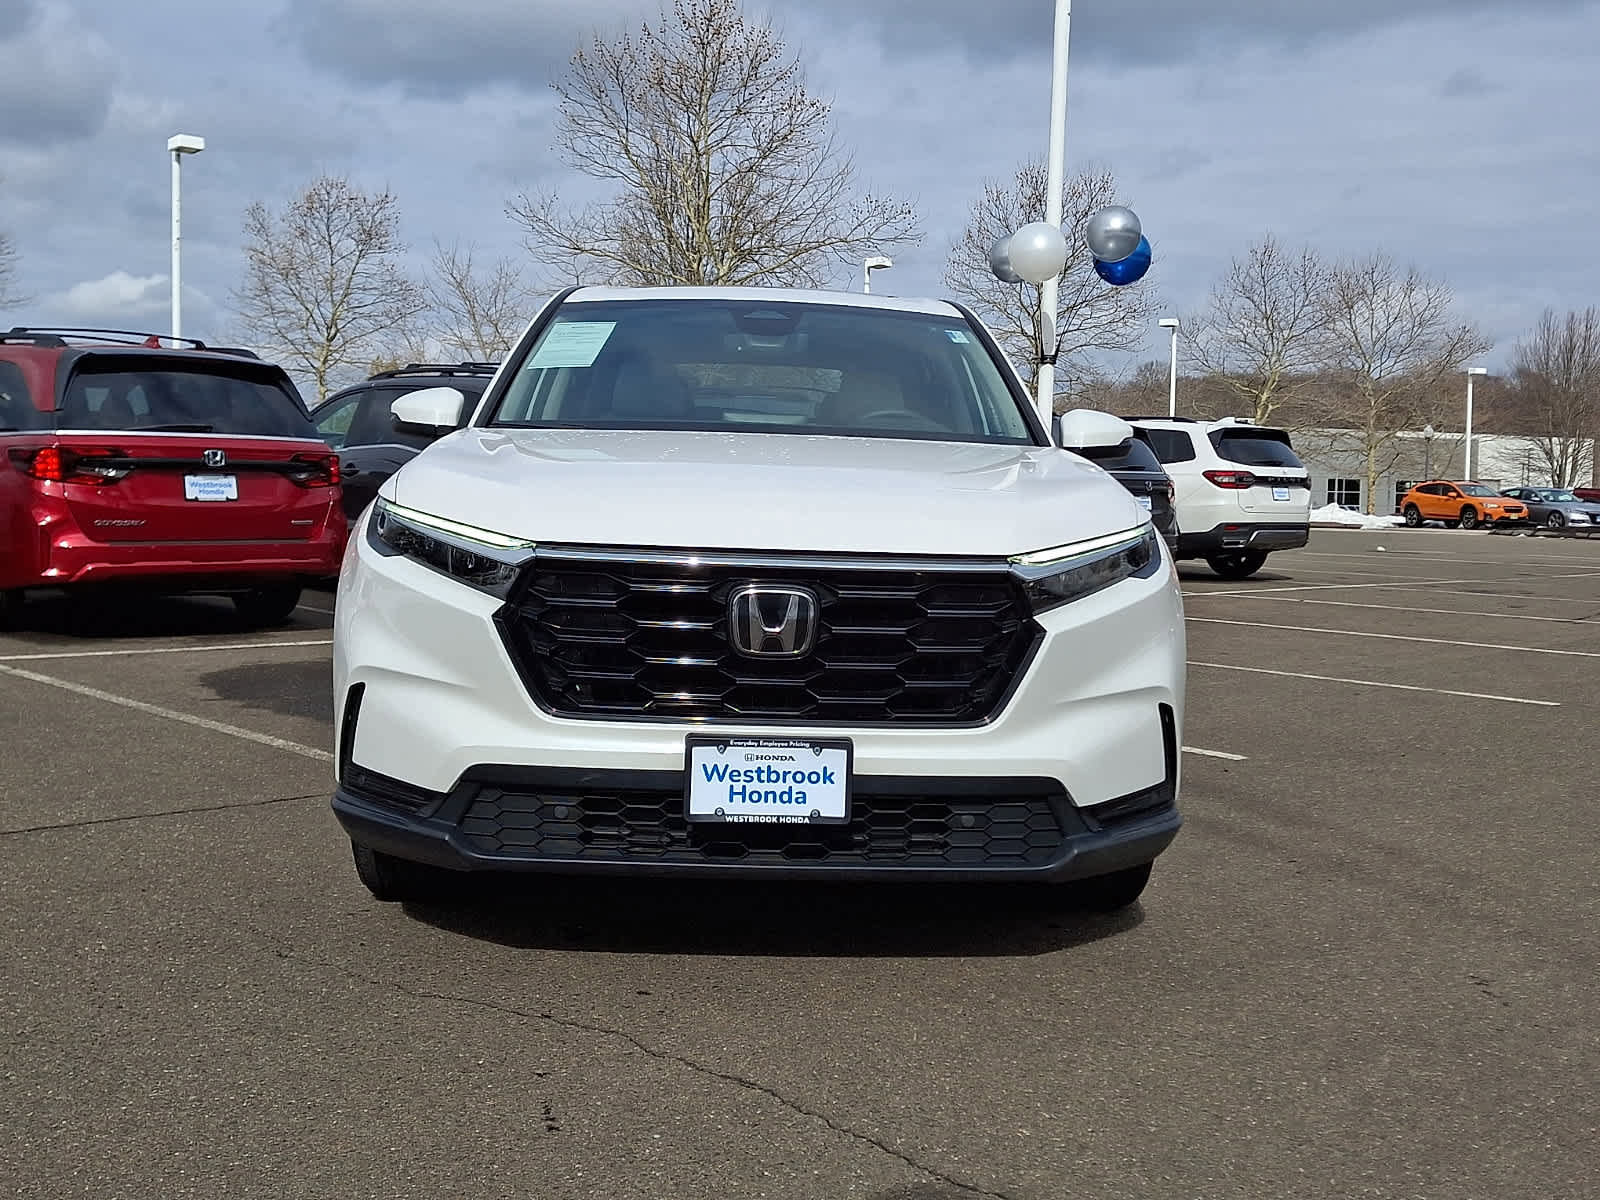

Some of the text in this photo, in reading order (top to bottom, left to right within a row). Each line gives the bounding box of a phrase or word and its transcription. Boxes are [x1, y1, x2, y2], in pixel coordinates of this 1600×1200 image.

[760, 740, 788, 748] Employee
[755, 754, 796, 762] HONDA
[702, 763, 836, 785] Westbrook
[728, 784, 808, 805] Honda
[725, 815, 810, 824] WESTBROOK HONDA
